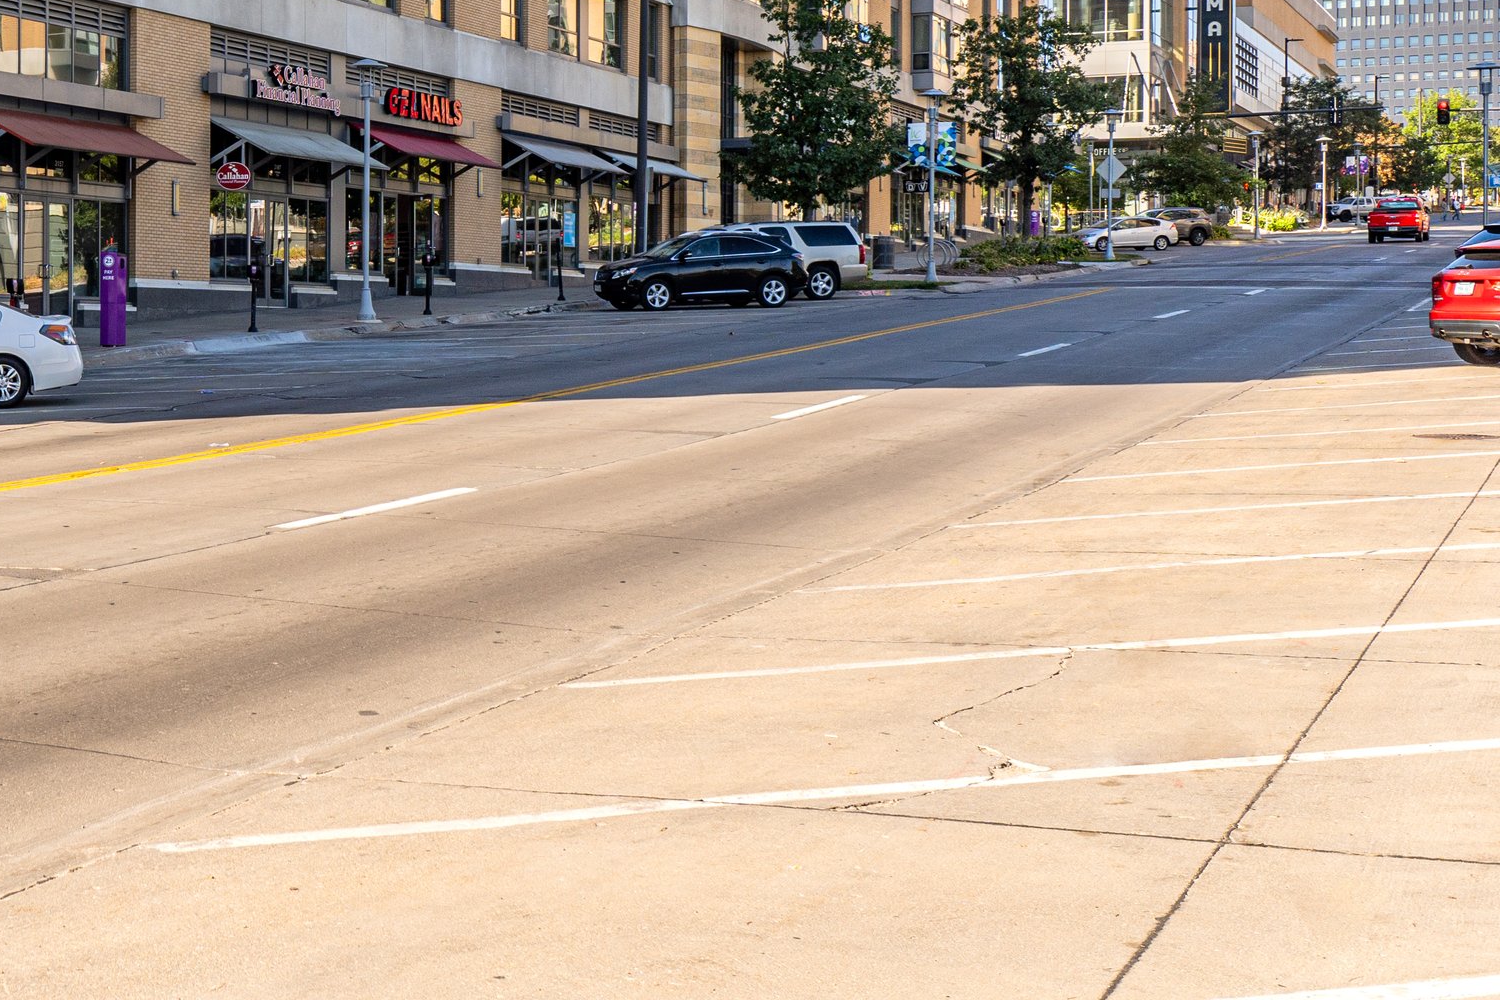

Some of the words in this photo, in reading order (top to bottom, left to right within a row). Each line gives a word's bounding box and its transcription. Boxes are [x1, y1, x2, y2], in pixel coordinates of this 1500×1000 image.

[283, 65, 326, 91] Callahan
[256, 79, 301, 105] Financial
[301, 87, 341, 117] Planning
[389, 87, 419, 119] GEL
[420, 92, 464, 127] NAILS
[217, 171, 249, 181] Callahan
